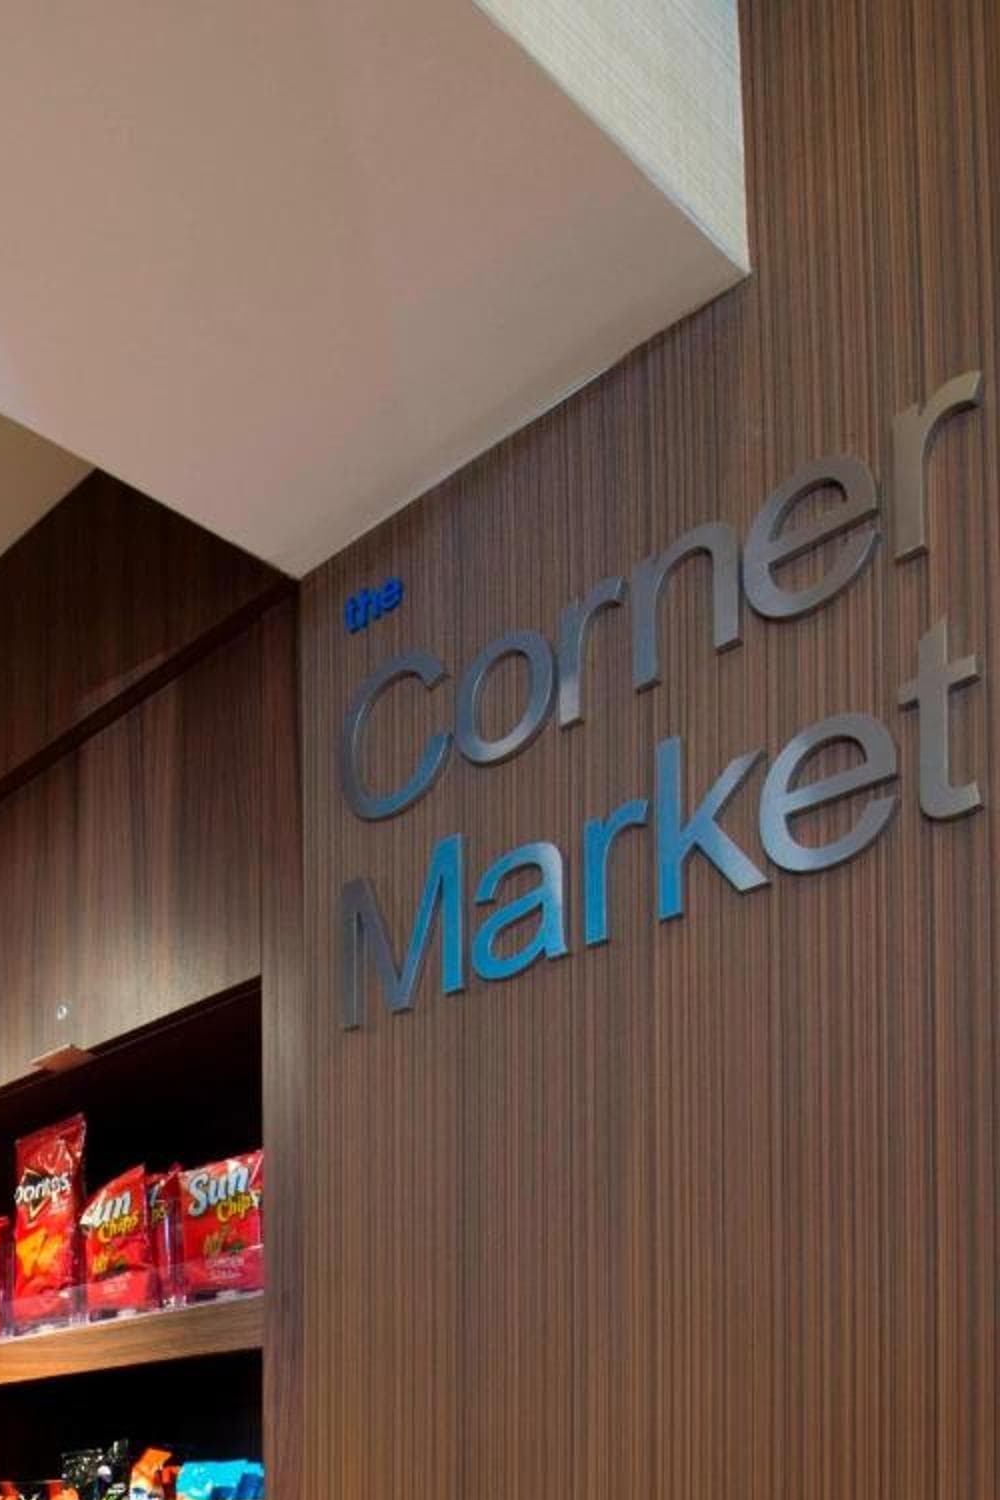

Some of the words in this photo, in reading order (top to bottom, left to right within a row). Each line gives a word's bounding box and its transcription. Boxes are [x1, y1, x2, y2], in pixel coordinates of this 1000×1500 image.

[342, 369, 982, 821] Corner
[344, 576, 404, 634] the
[342, 615, 983, 1031] Market
[188, 1166, 249, 1217] Sun
